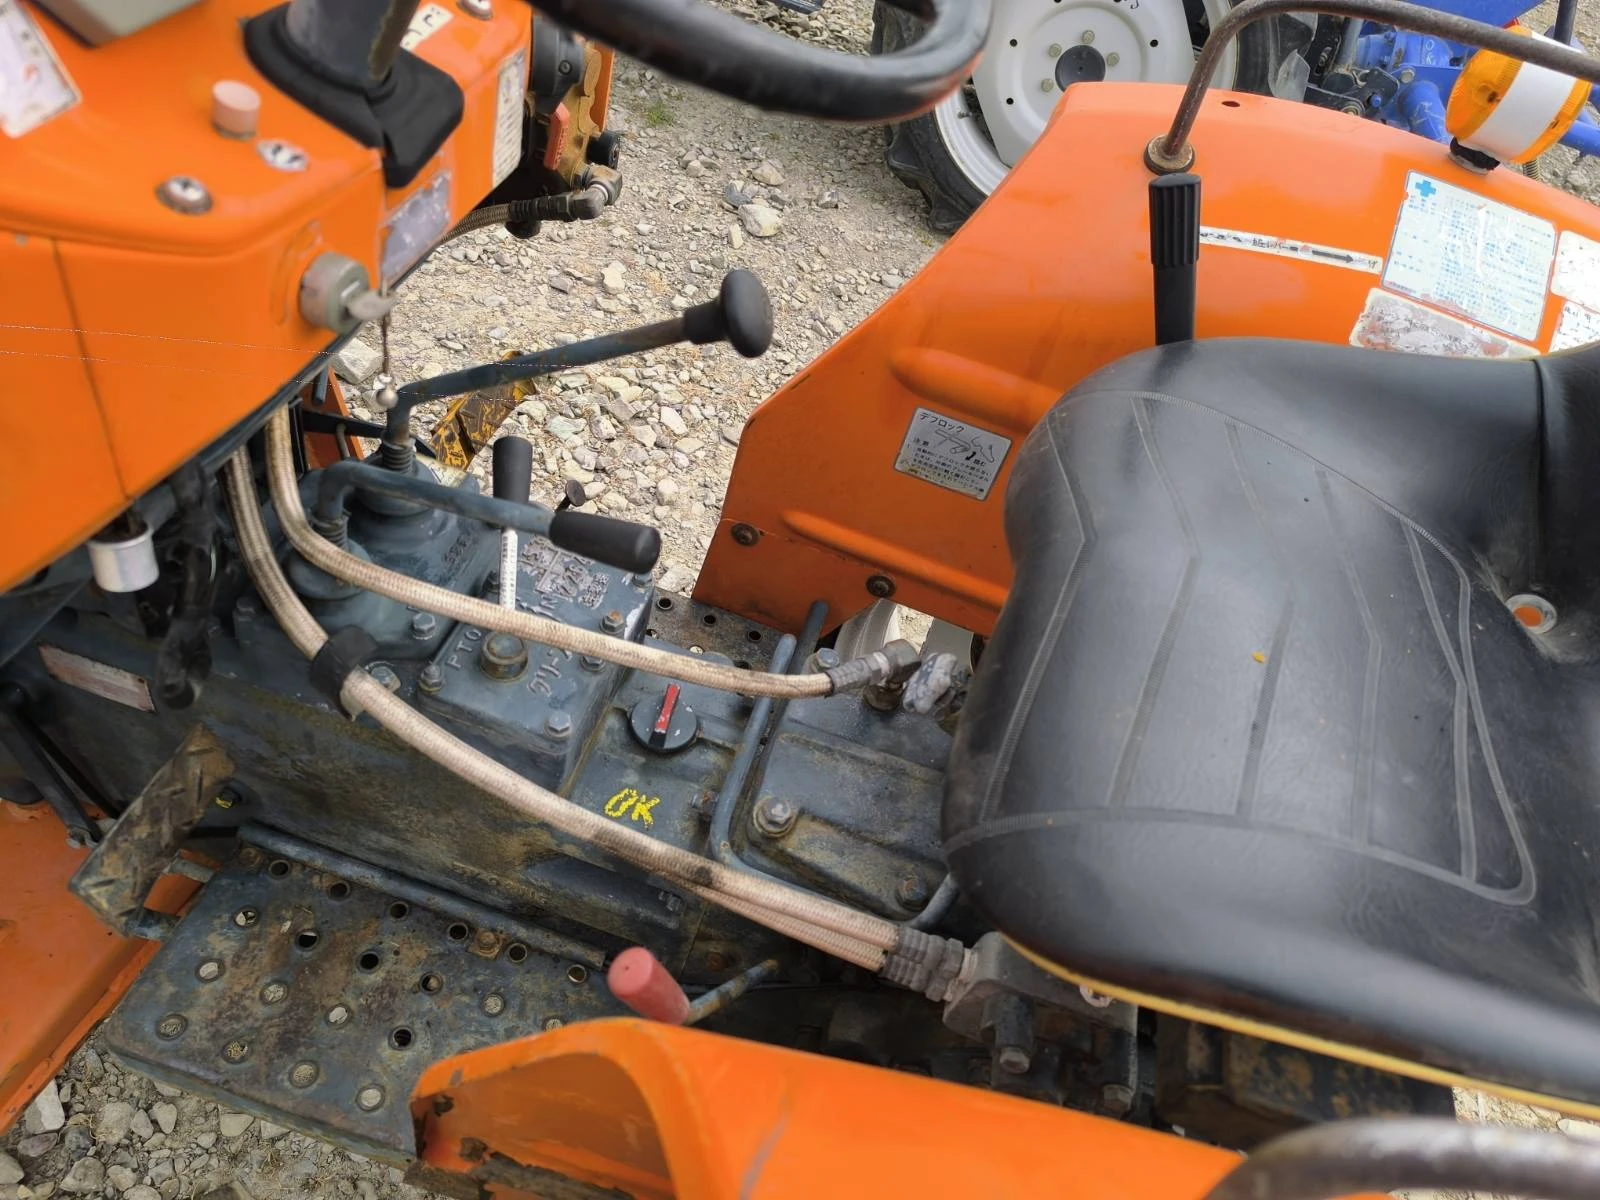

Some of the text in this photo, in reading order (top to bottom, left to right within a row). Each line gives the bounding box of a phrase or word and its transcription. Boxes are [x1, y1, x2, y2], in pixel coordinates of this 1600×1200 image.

[919, 412, 965, 433] デフロック
[446, 629, 482, 670] PTO
[604, 788, 660, 827] OK
